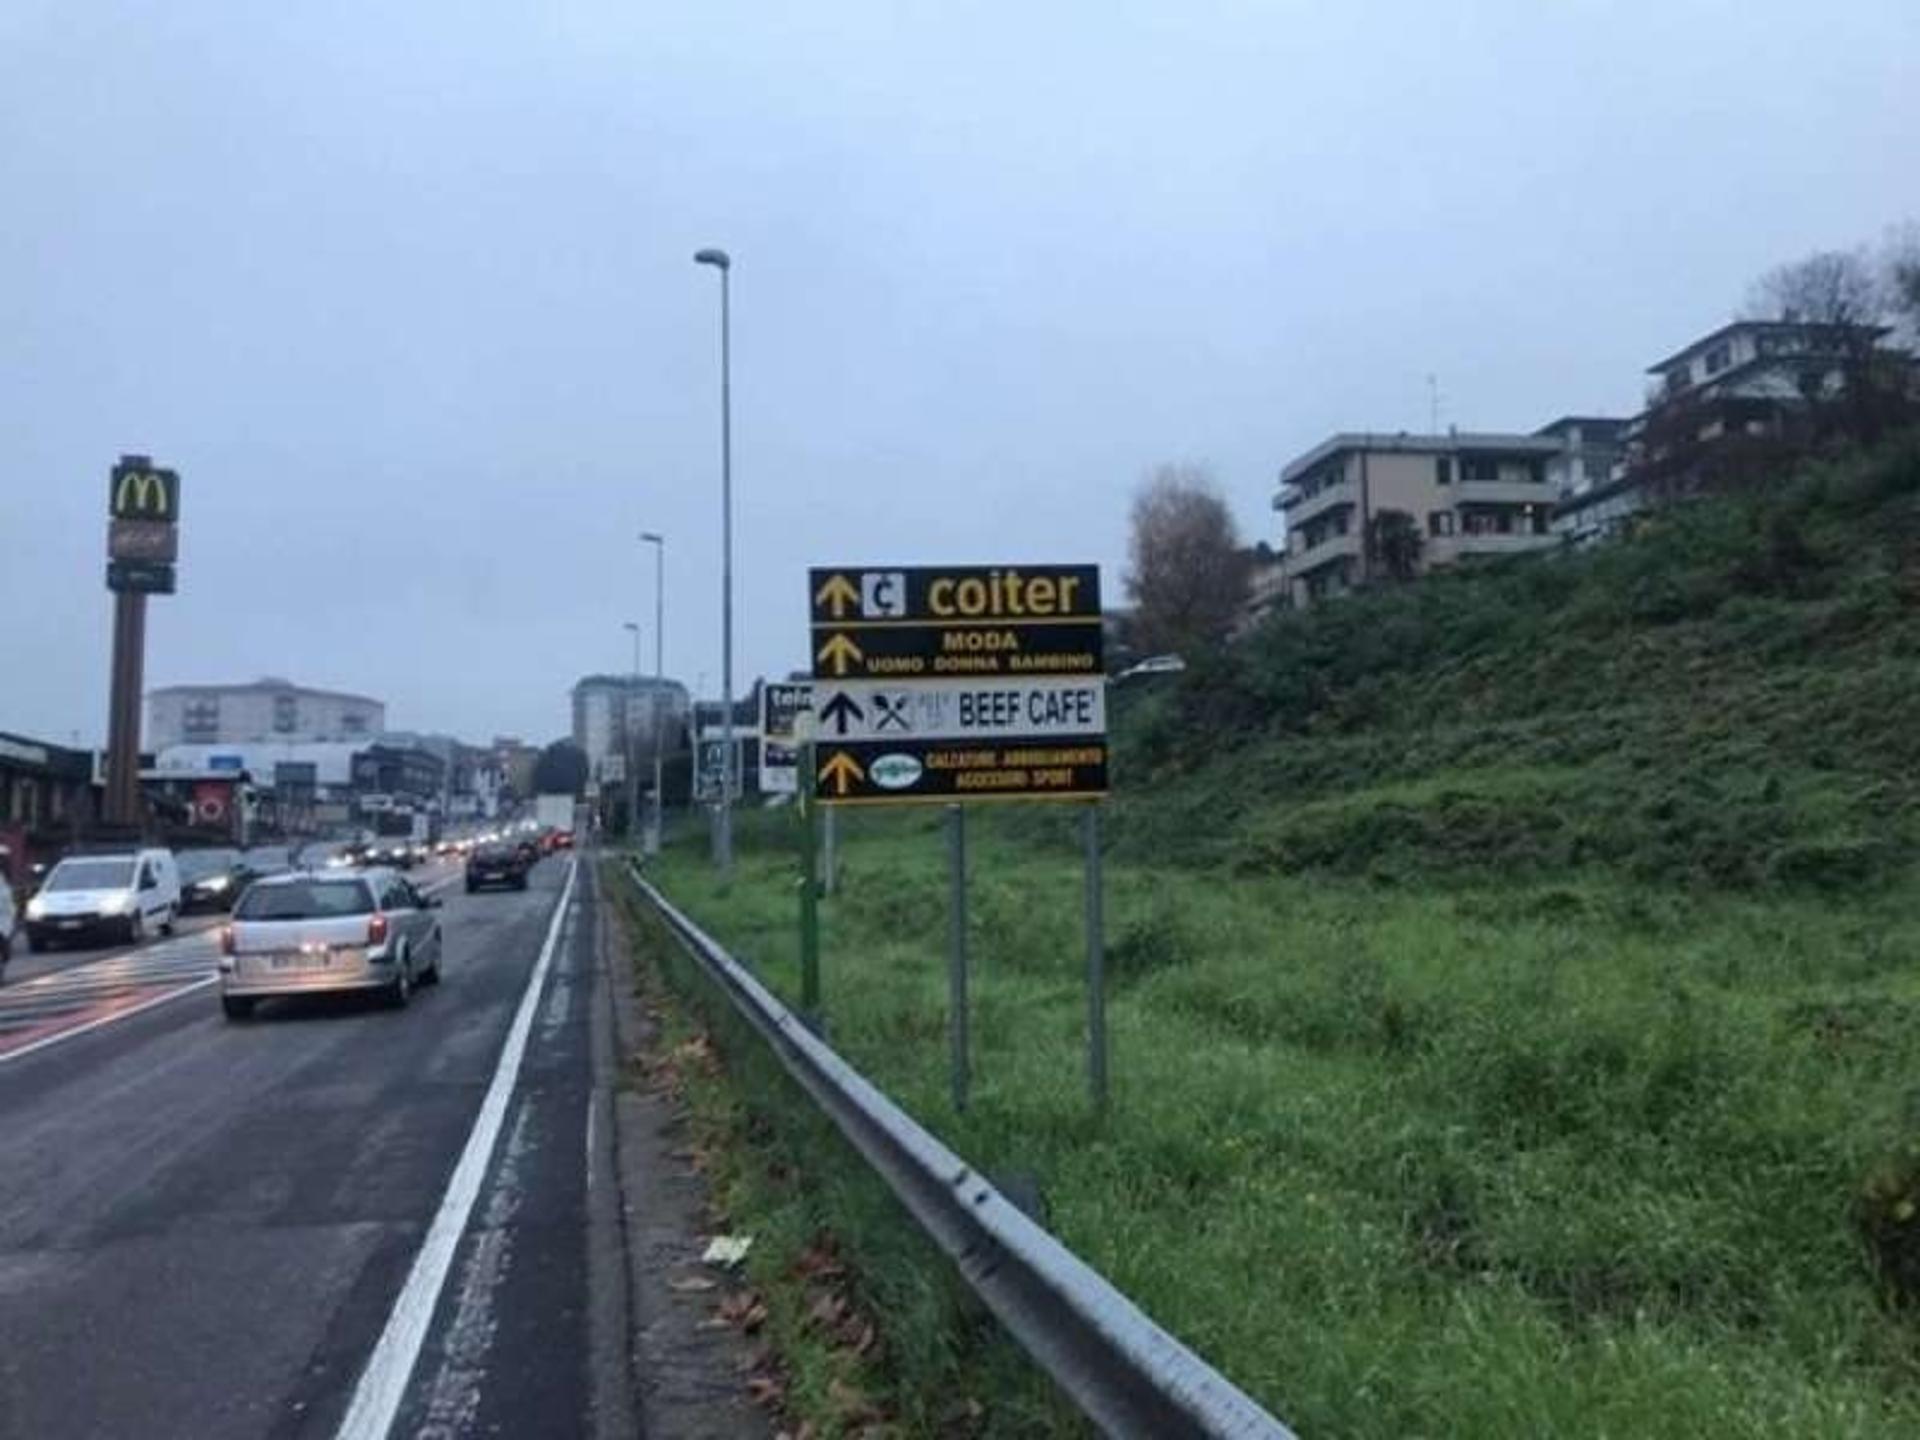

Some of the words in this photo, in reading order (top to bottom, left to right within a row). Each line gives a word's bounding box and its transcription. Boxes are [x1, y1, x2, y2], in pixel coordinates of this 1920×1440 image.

[928, 569, 1080, 616] coiter
[943, 631, 1018, 651] MODA
[866, 656, 925, 673] UOMO
[933, 655, 999, 671] DONNA
[1009, 652, 1094, 670] BAMBINO
[958, 691, 1021, 728] BEEF
